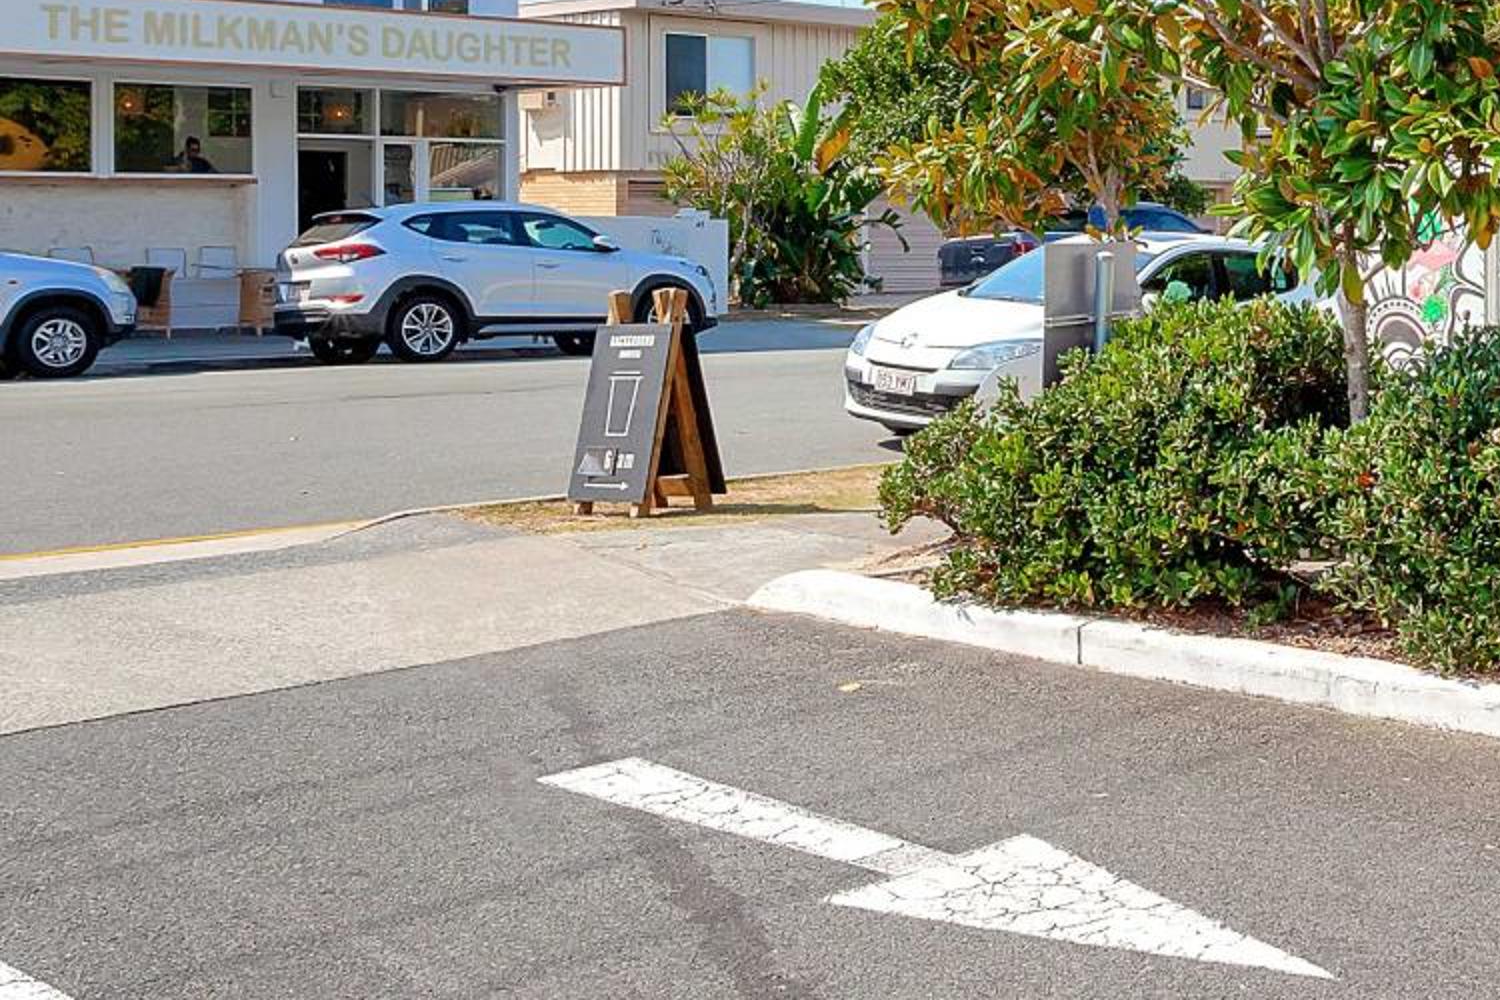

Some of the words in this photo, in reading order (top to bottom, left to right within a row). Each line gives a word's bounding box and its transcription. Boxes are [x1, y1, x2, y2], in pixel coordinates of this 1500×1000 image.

[39, 3, 130, 44] THE
[142, 9, 370, 57] MILKMAN'S
[381, 23, 572, 69] DAUGHTER
